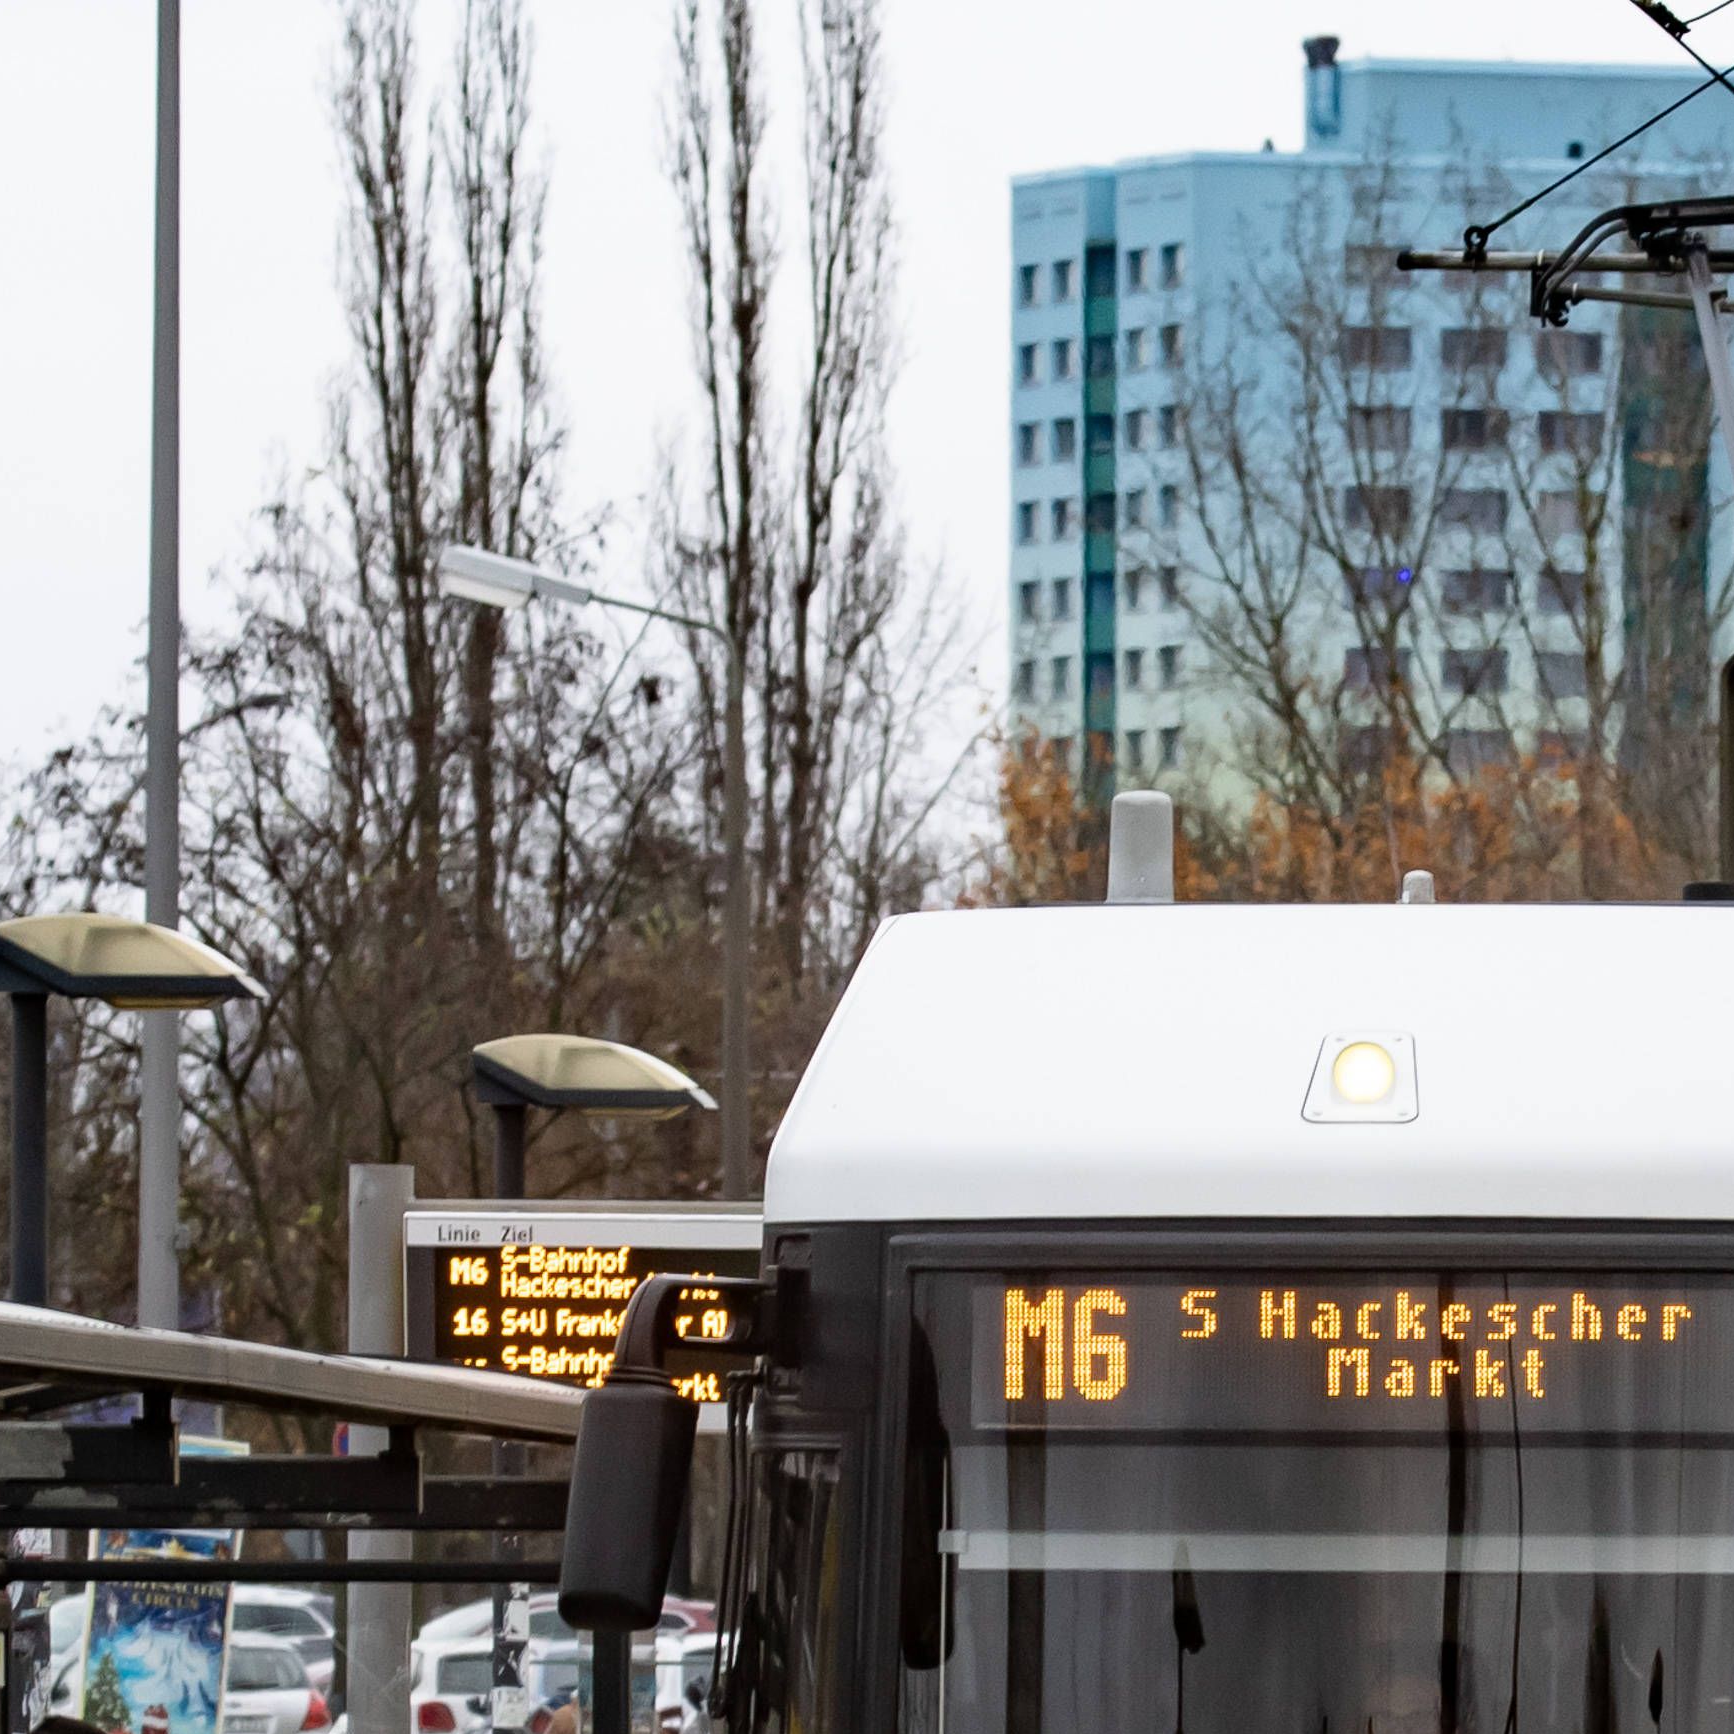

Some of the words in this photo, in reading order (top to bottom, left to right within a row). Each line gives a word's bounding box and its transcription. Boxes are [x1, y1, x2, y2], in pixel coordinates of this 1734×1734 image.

[437, 1225, 481, 1242] Linie
[500, 1225, 534, 1242] Ziel
[449, 1256, 489, 1285] M6
[500, 1245, 630, 1273] S-Bahnhof
[500, 1271, 637, 1298] Hackescher
[452, 1307, 490, 1336] 16
[500, 1308, 548, 1337] S+U
[1005, 1289, 1126, 1400] M6
[1181, 1290, 1217, 1338] S
[1259, 1290, 1692, 1341] Hackescher
[500, 1345, 616, 1376] S-Bahnh
[1327, 1347, 1546, 1399] Markt
